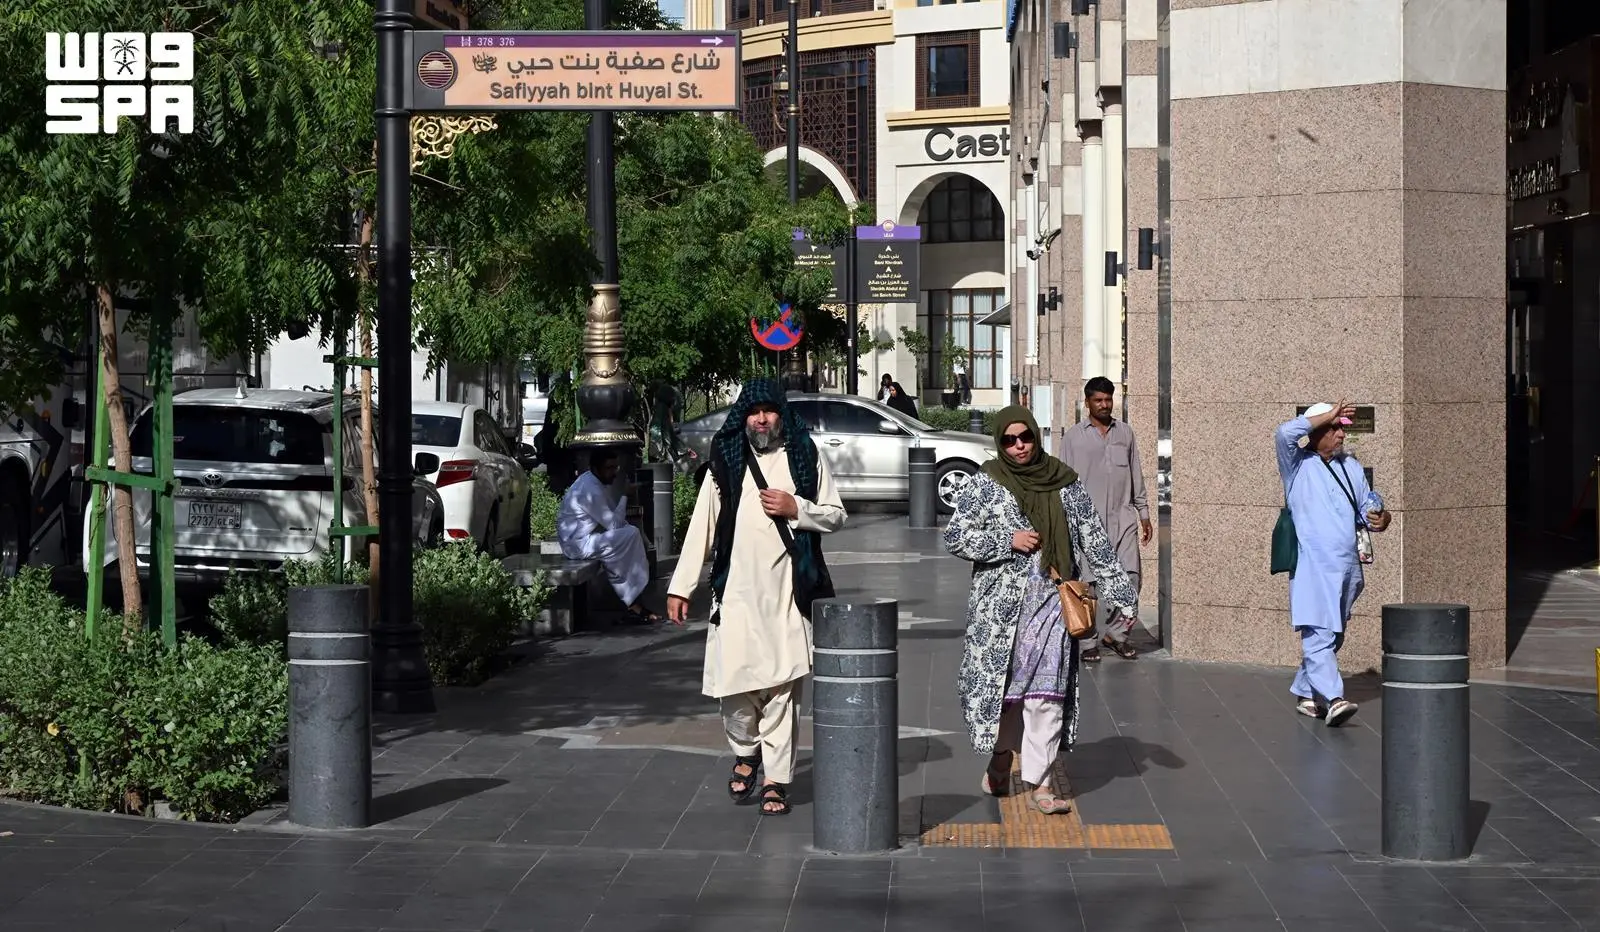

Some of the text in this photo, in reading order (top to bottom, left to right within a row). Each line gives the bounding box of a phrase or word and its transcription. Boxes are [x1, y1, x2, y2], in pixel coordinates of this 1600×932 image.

[477, 37, 515, 46] 378 376
[507, 57, 554, 79] حيي
[560, 53, 600, 75] بنت
[606, 51, 665, 75] صفية
[671, 49, 720, 73] شارع
[490, 82, 703, 103] Safiyyah bint Huyai St.
[190, 515, 214, 527] 2737
